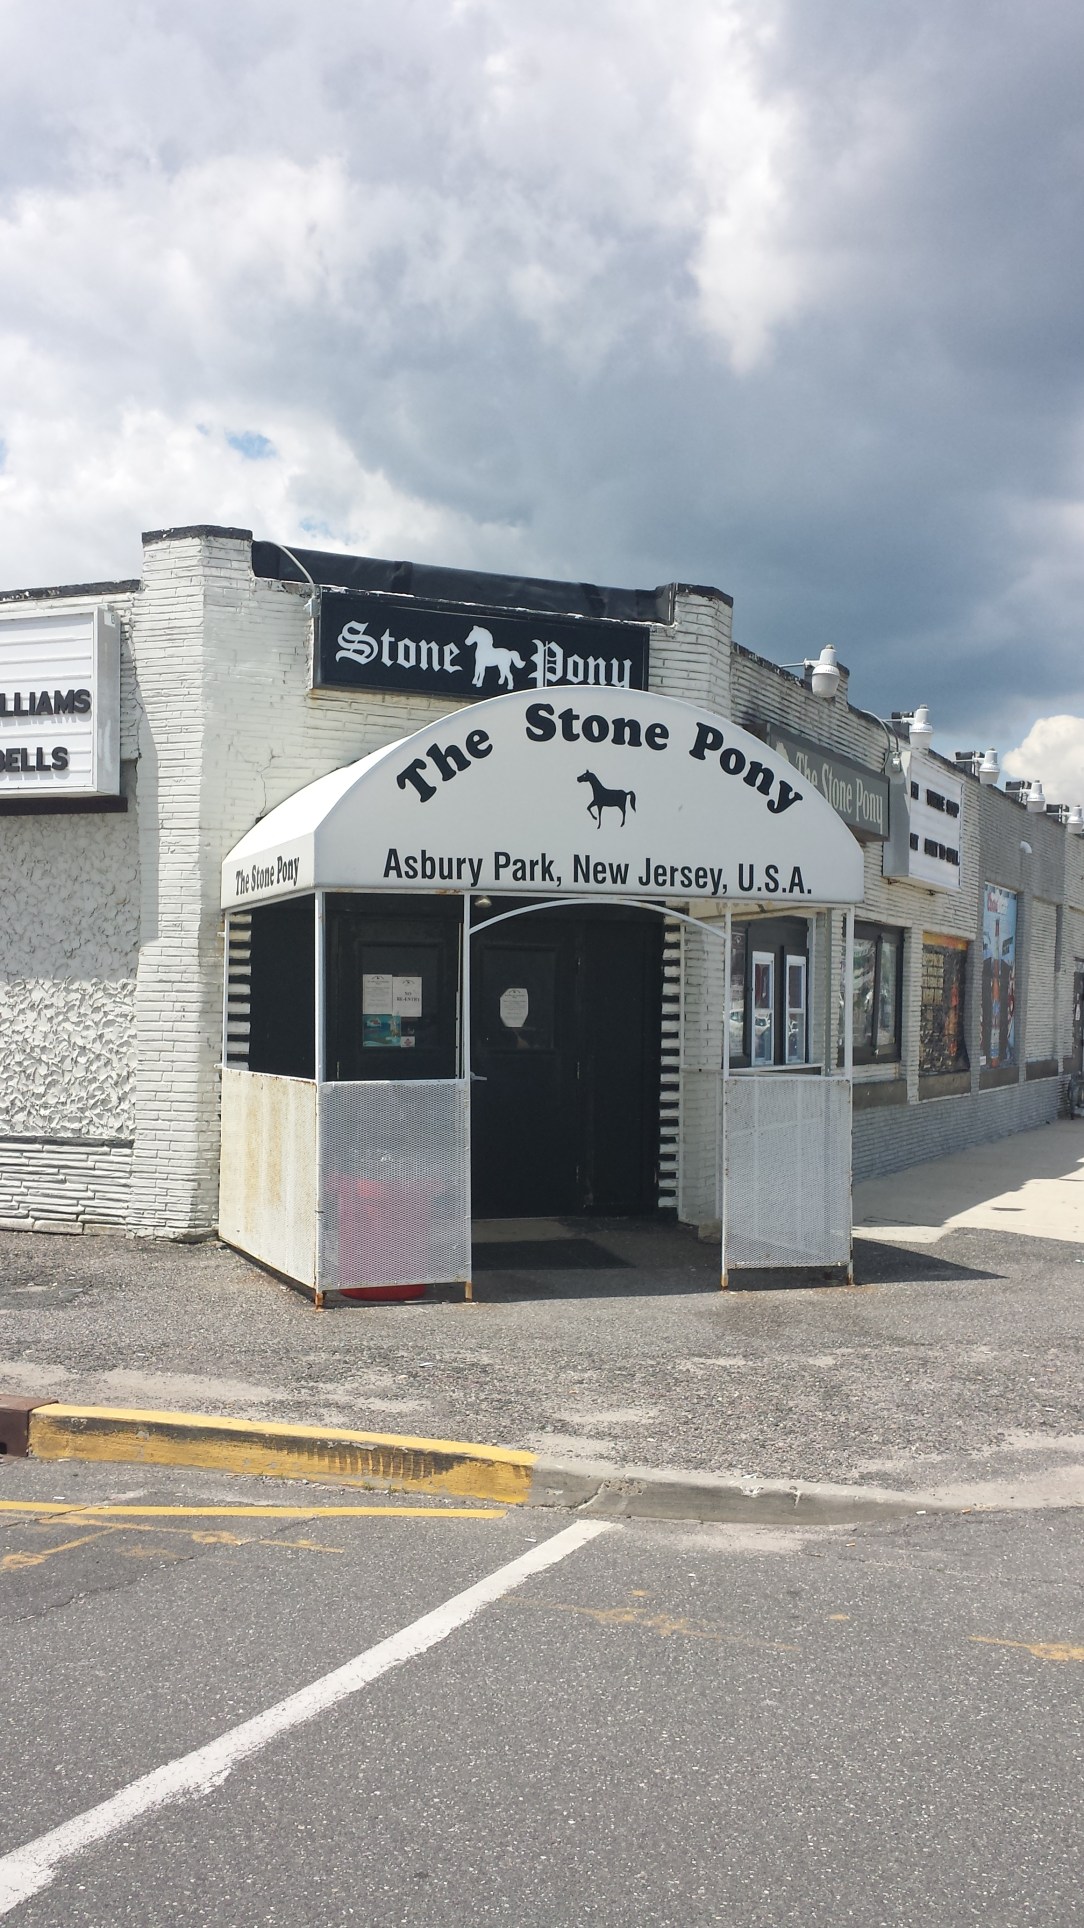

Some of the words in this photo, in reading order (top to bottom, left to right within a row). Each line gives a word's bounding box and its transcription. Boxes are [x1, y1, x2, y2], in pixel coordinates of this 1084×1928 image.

[335, 620, 463, 673] Stone
[527, 639, 633, 688] Pony
[396, 729, 493, 803] The
[525, 703, 670, 751] Stone
[689, 721, 804, 814] Pony
[821, 762, 853, 814] Stone
[855, 777, 883, 835] Pony
[235, 868, 250, 896] The
[250, 864, 275, 892] Stone
[276, 855, 300, 887] Pony
[383, 848, 483, 887] Asbury
[494, 851, 562, 888] Park,
[573, 854, 630, 885] New
[638, 857, 728, 895] Jersey,
[738, 863, 812, 895] U.S.A.
